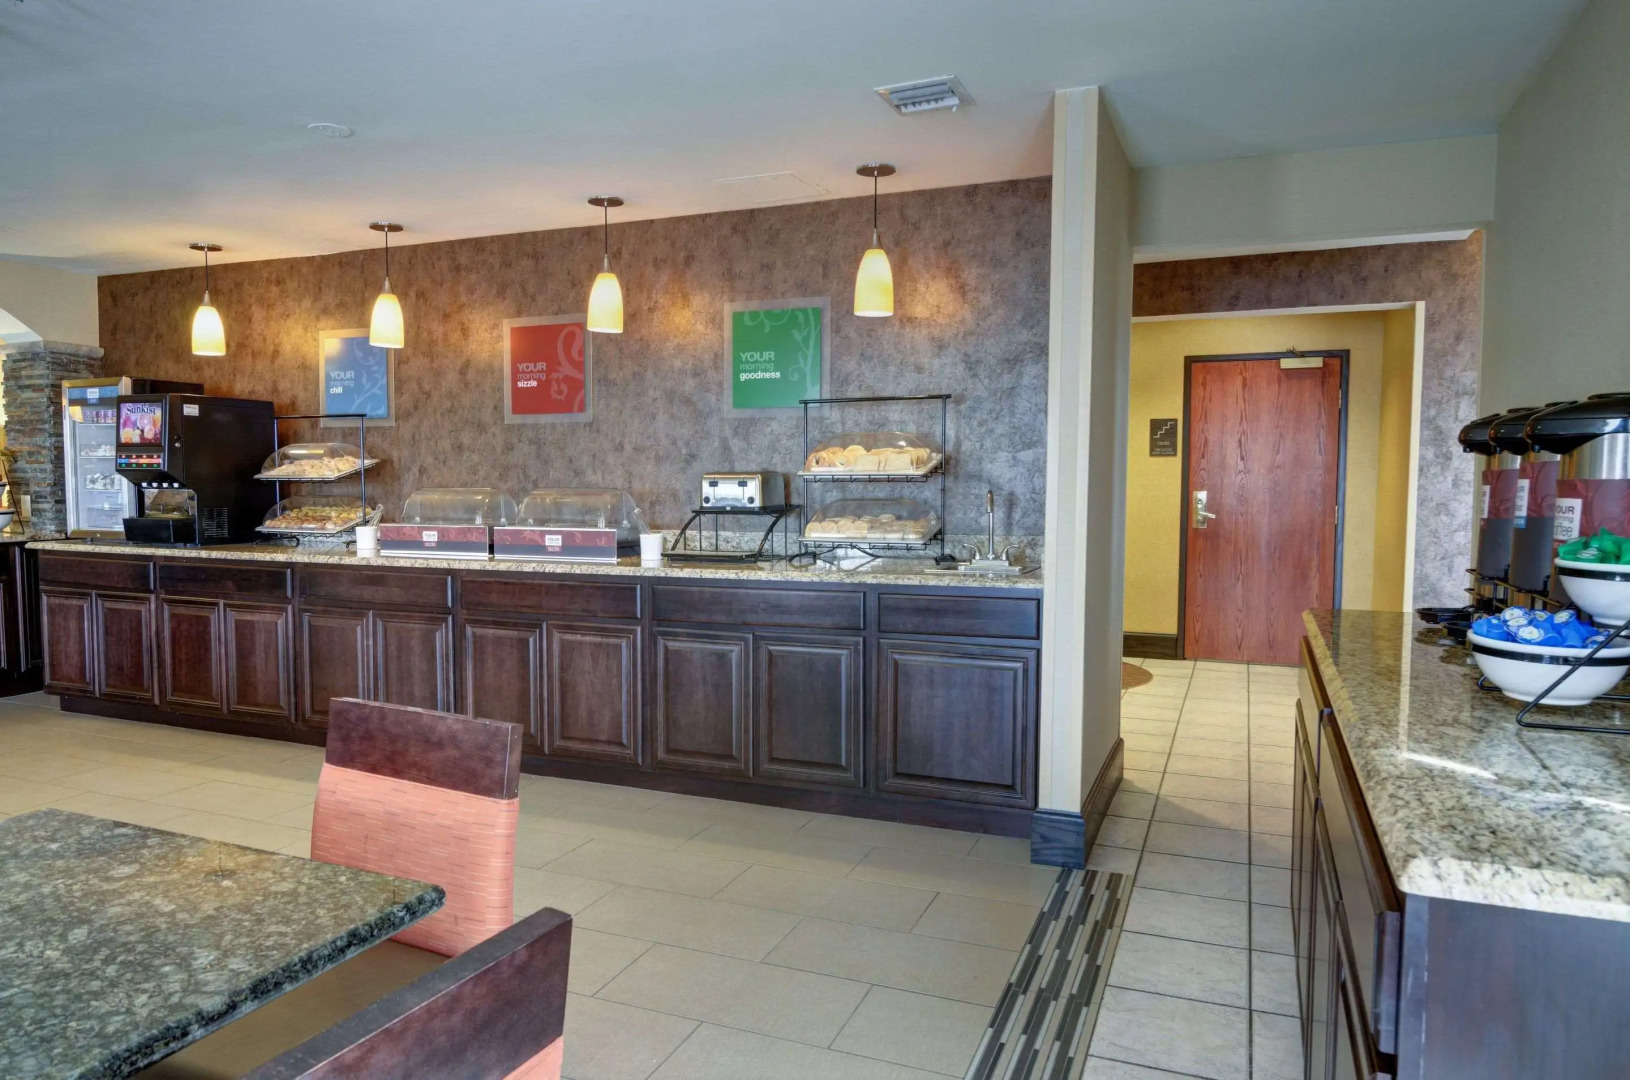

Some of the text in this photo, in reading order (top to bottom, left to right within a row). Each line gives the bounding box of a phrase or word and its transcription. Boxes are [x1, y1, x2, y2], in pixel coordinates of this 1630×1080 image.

[740, 351, 775, 362] YOUR
[517, 362, 546, 371] YOUR
[740, 362, 774, 371] morning
[330, 371, 355, 380] YOUR
[518, 372, 546, 380] morning
[740, 370, 781, 381] goodness
[517, 379, 538, 387] sizzle
[330, 386, 343, 394] chill
[126, 403, 156, 415] Sunkist
[1556, 505, 1575, 515] OUR
